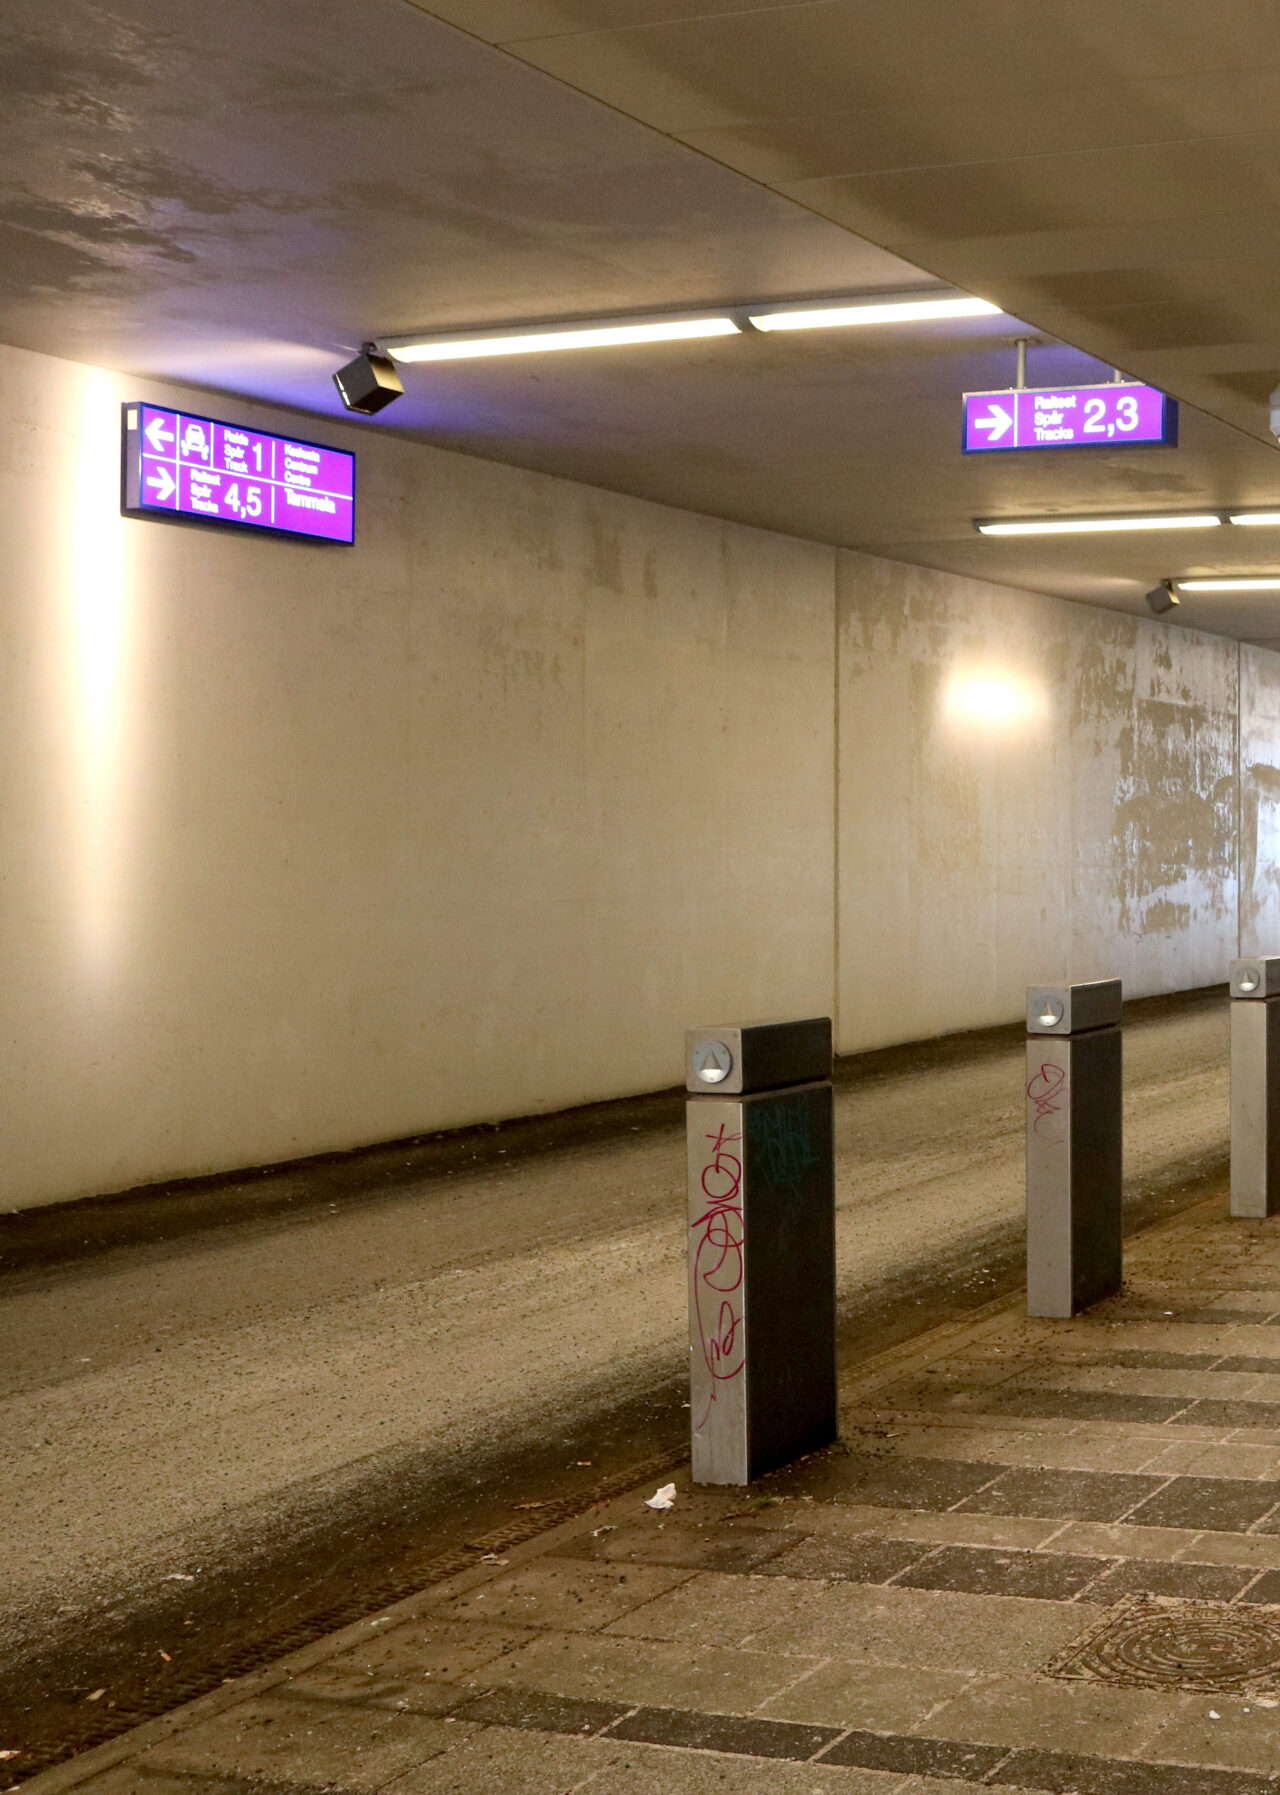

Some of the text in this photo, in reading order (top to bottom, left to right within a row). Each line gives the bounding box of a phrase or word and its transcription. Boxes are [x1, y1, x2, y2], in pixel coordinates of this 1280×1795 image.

[1083, 396, 1139, 438] 2,3
[1033, 426, 1074, 441] Tracks
[252, 442, 262, 471] 1
[224, 483, 262, 519] 4,5
